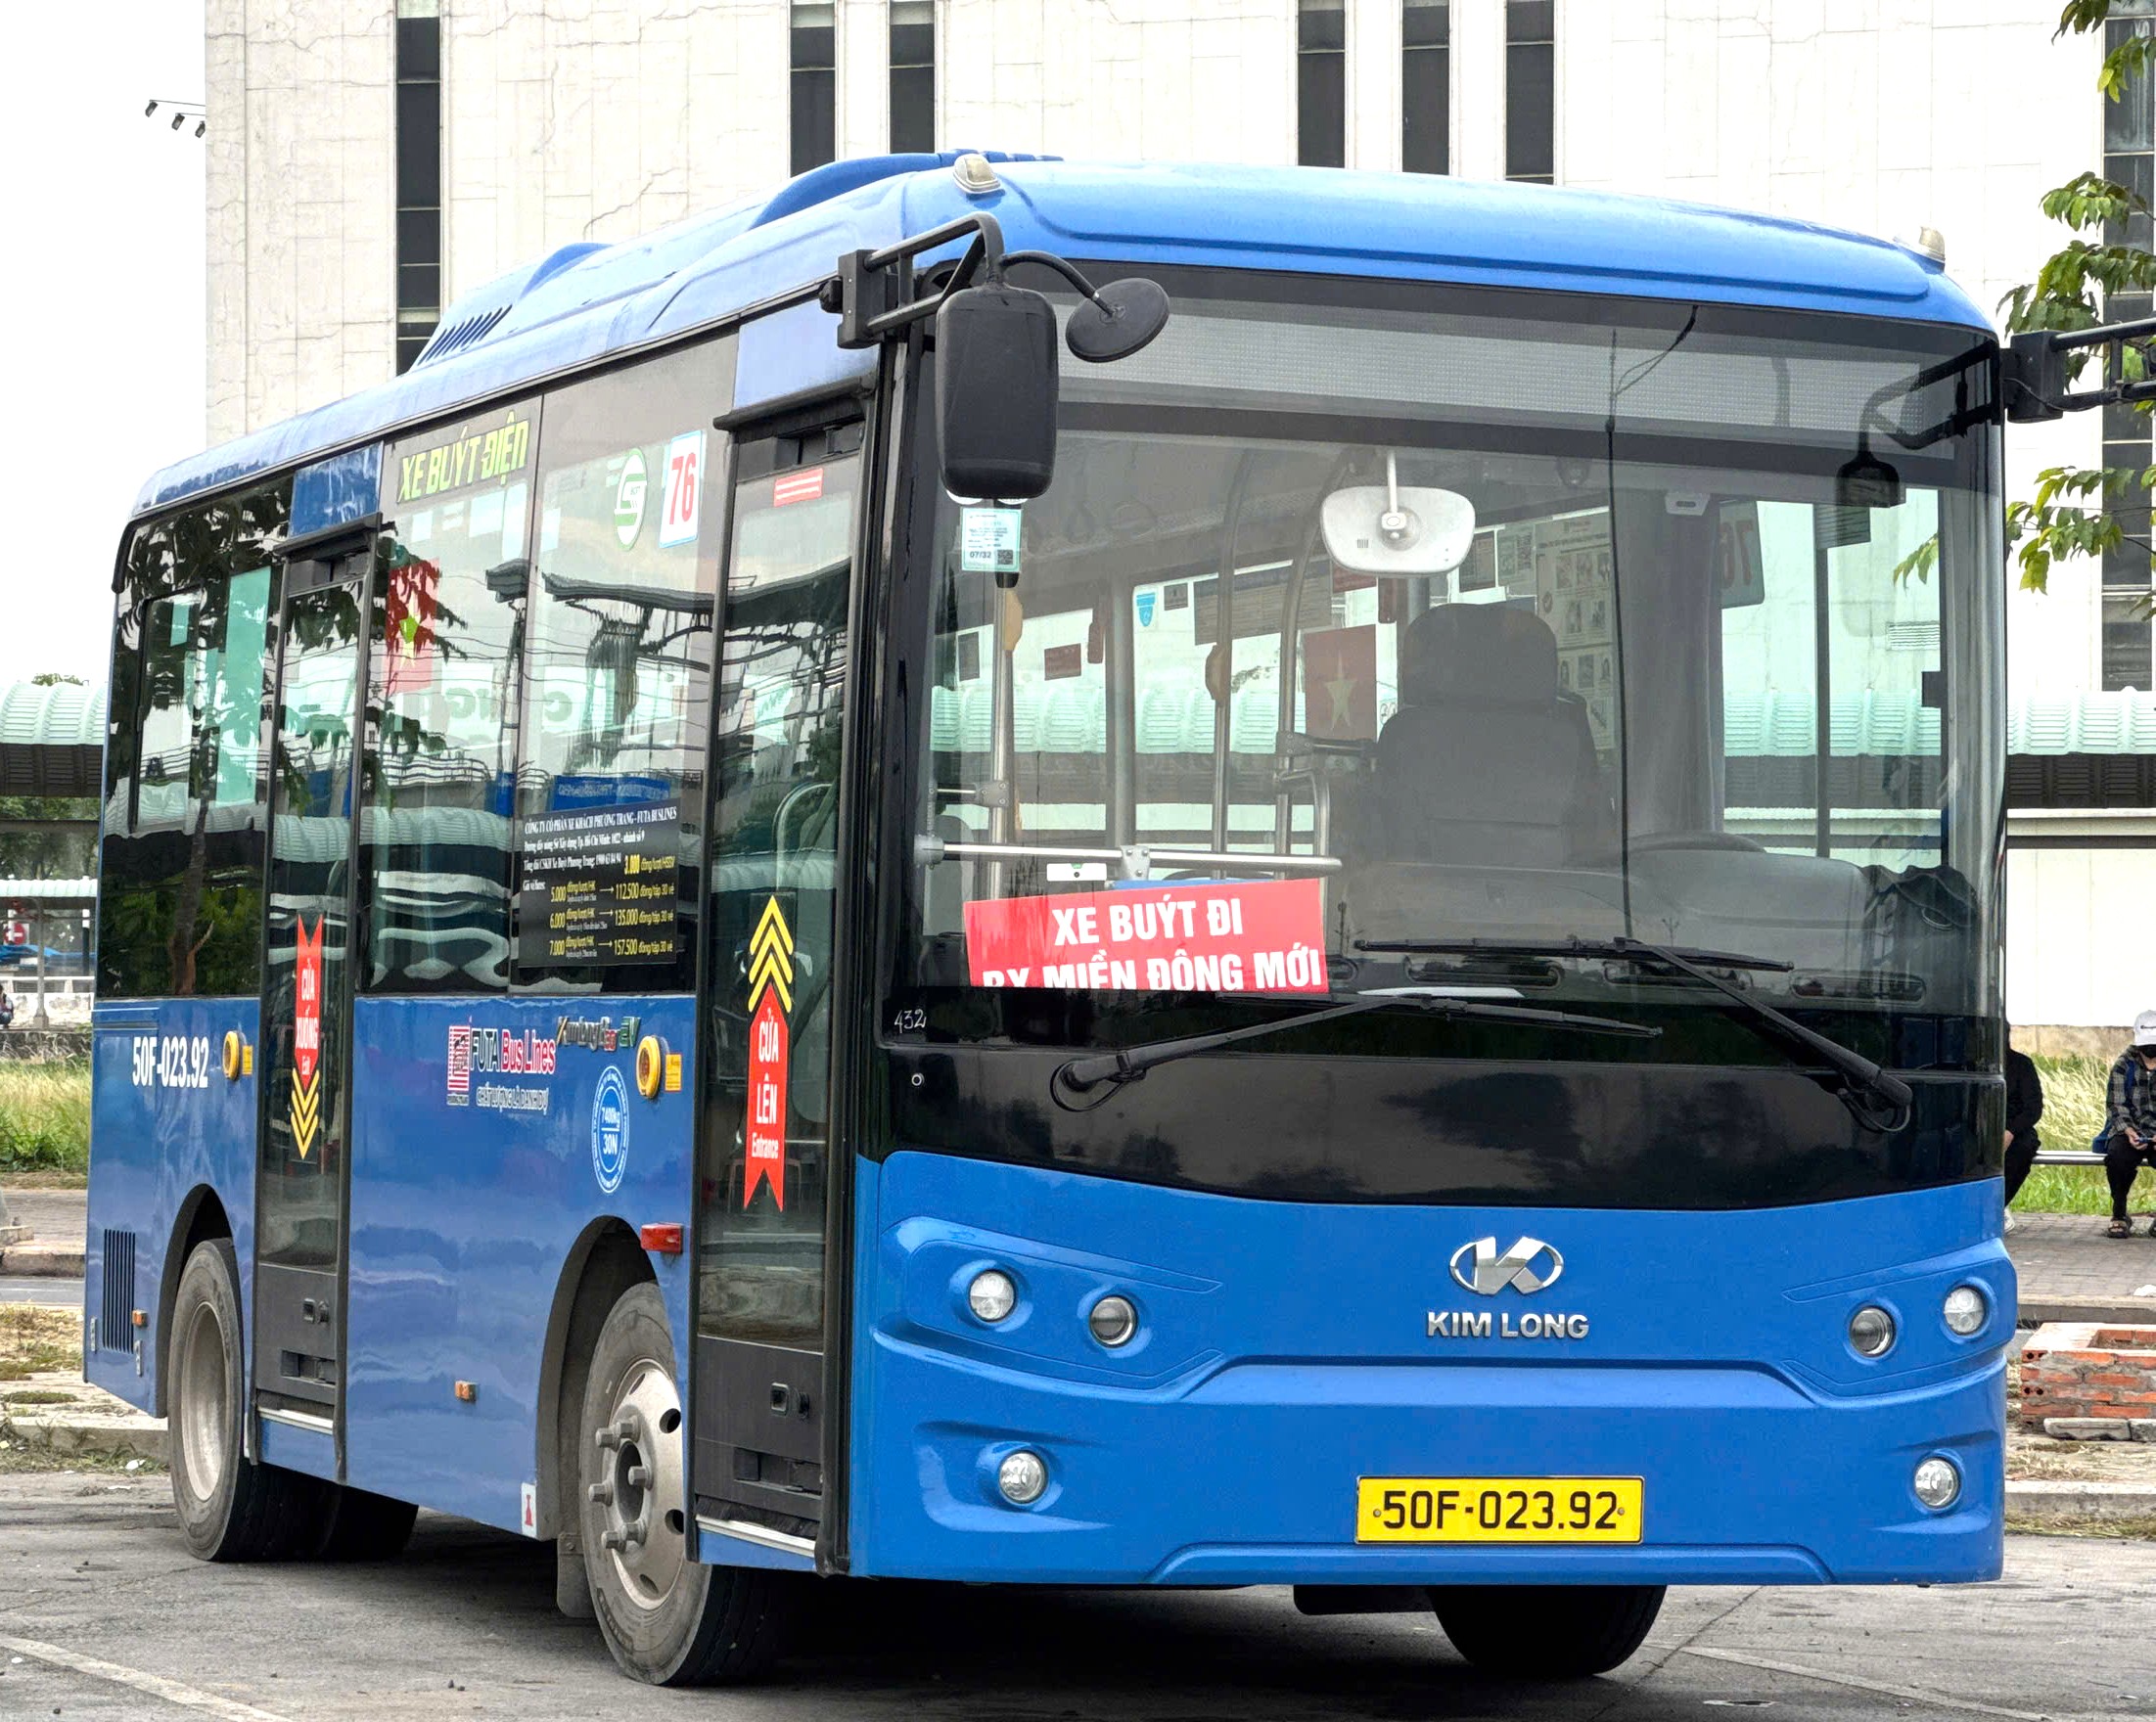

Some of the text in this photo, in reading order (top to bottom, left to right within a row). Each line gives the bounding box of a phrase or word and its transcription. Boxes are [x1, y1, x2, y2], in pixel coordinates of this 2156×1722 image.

[397, 452, 427, 503] XE
[426, 426, 482, 495] BUÝT
[669, 452, 697, 525] 76
[616, 883, 639, 900] 112.500
[615, 908, 638, 926] 135.000
[1051, 894, 1243, 946] XE BUÝT ĐI
[614, 939, 637, 955] 157.500
[1146, 949, 1244, 992] ĐÔNG
[1254, 942, 1322, 989] MỚI
[758, 1007, 779, 1063] CỬA
[894, 1008, 927, 1034] 432
[132, 1036, 209, 1088] 50F-023.92
[470, 1027, 500, 1072] FUTA
[500, 1029, 523, 1074] Bus
[524, 1028, 556, 1075] Lines
[756, 1072, 777, 1124] LÊN
[752, 1131, 779, 1159] Entrance
[1427, 1311, 1589, 1339] KIM LONG
[1383, 1490, 1618, 1529] 50F-023.92
